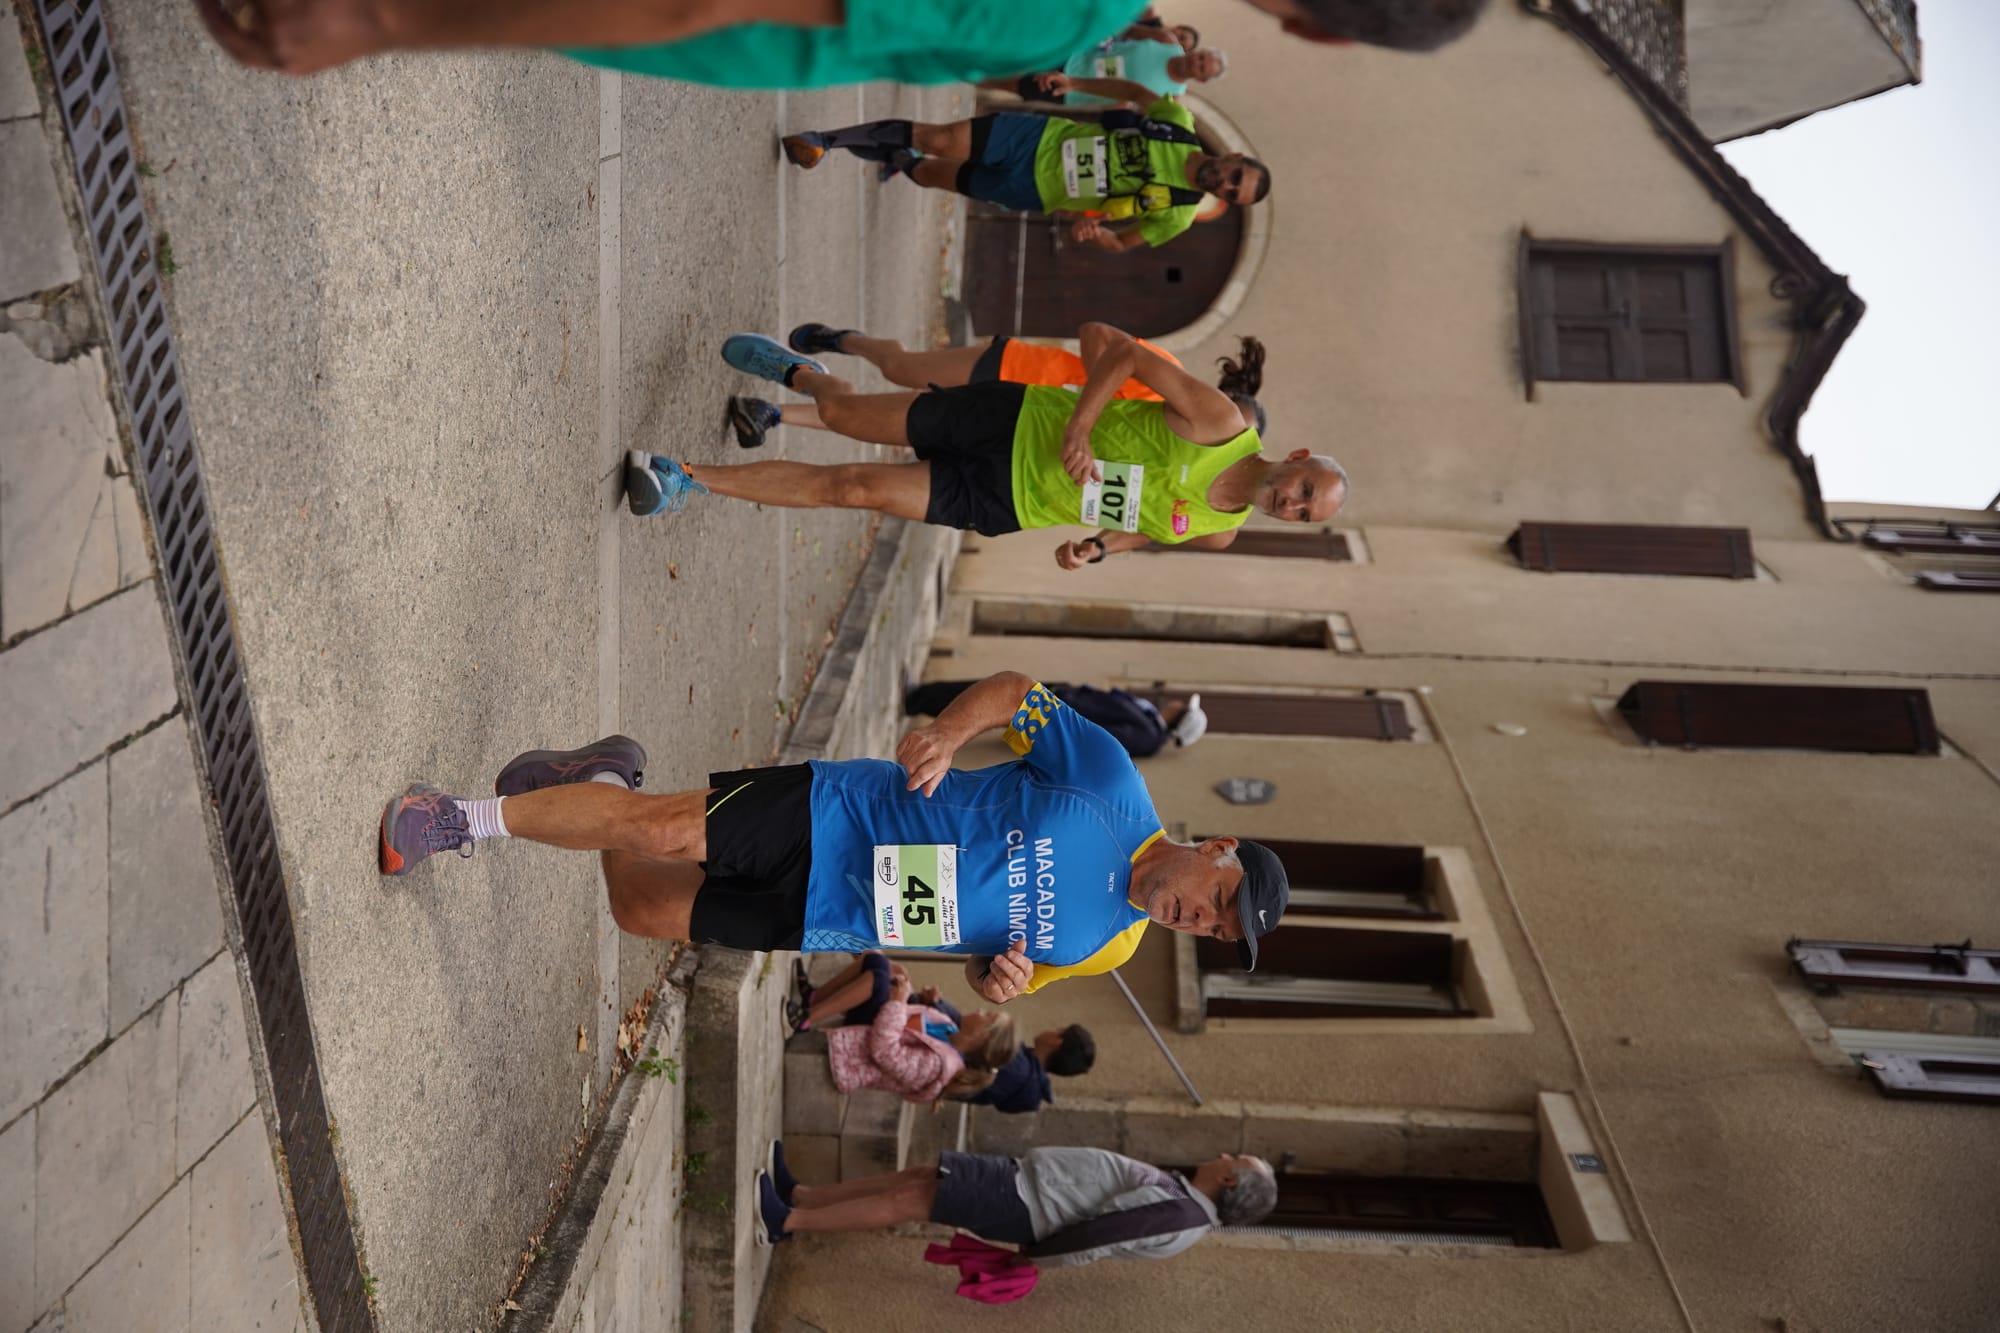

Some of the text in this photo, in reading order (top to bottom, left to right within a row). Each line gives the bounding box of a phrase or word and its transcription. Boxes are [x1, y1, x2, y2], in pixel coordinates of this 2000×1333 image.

[1077, 154, 1095, 178] 51
[1100, 474, 1127, 523] 107
[884, 856, 892, 882] BFP
[1006, 829, 1031, 950] CLUB NÎMO
[1034, 838, 1055, 949] MACADAM
[902, 875, 936, 926] 45
